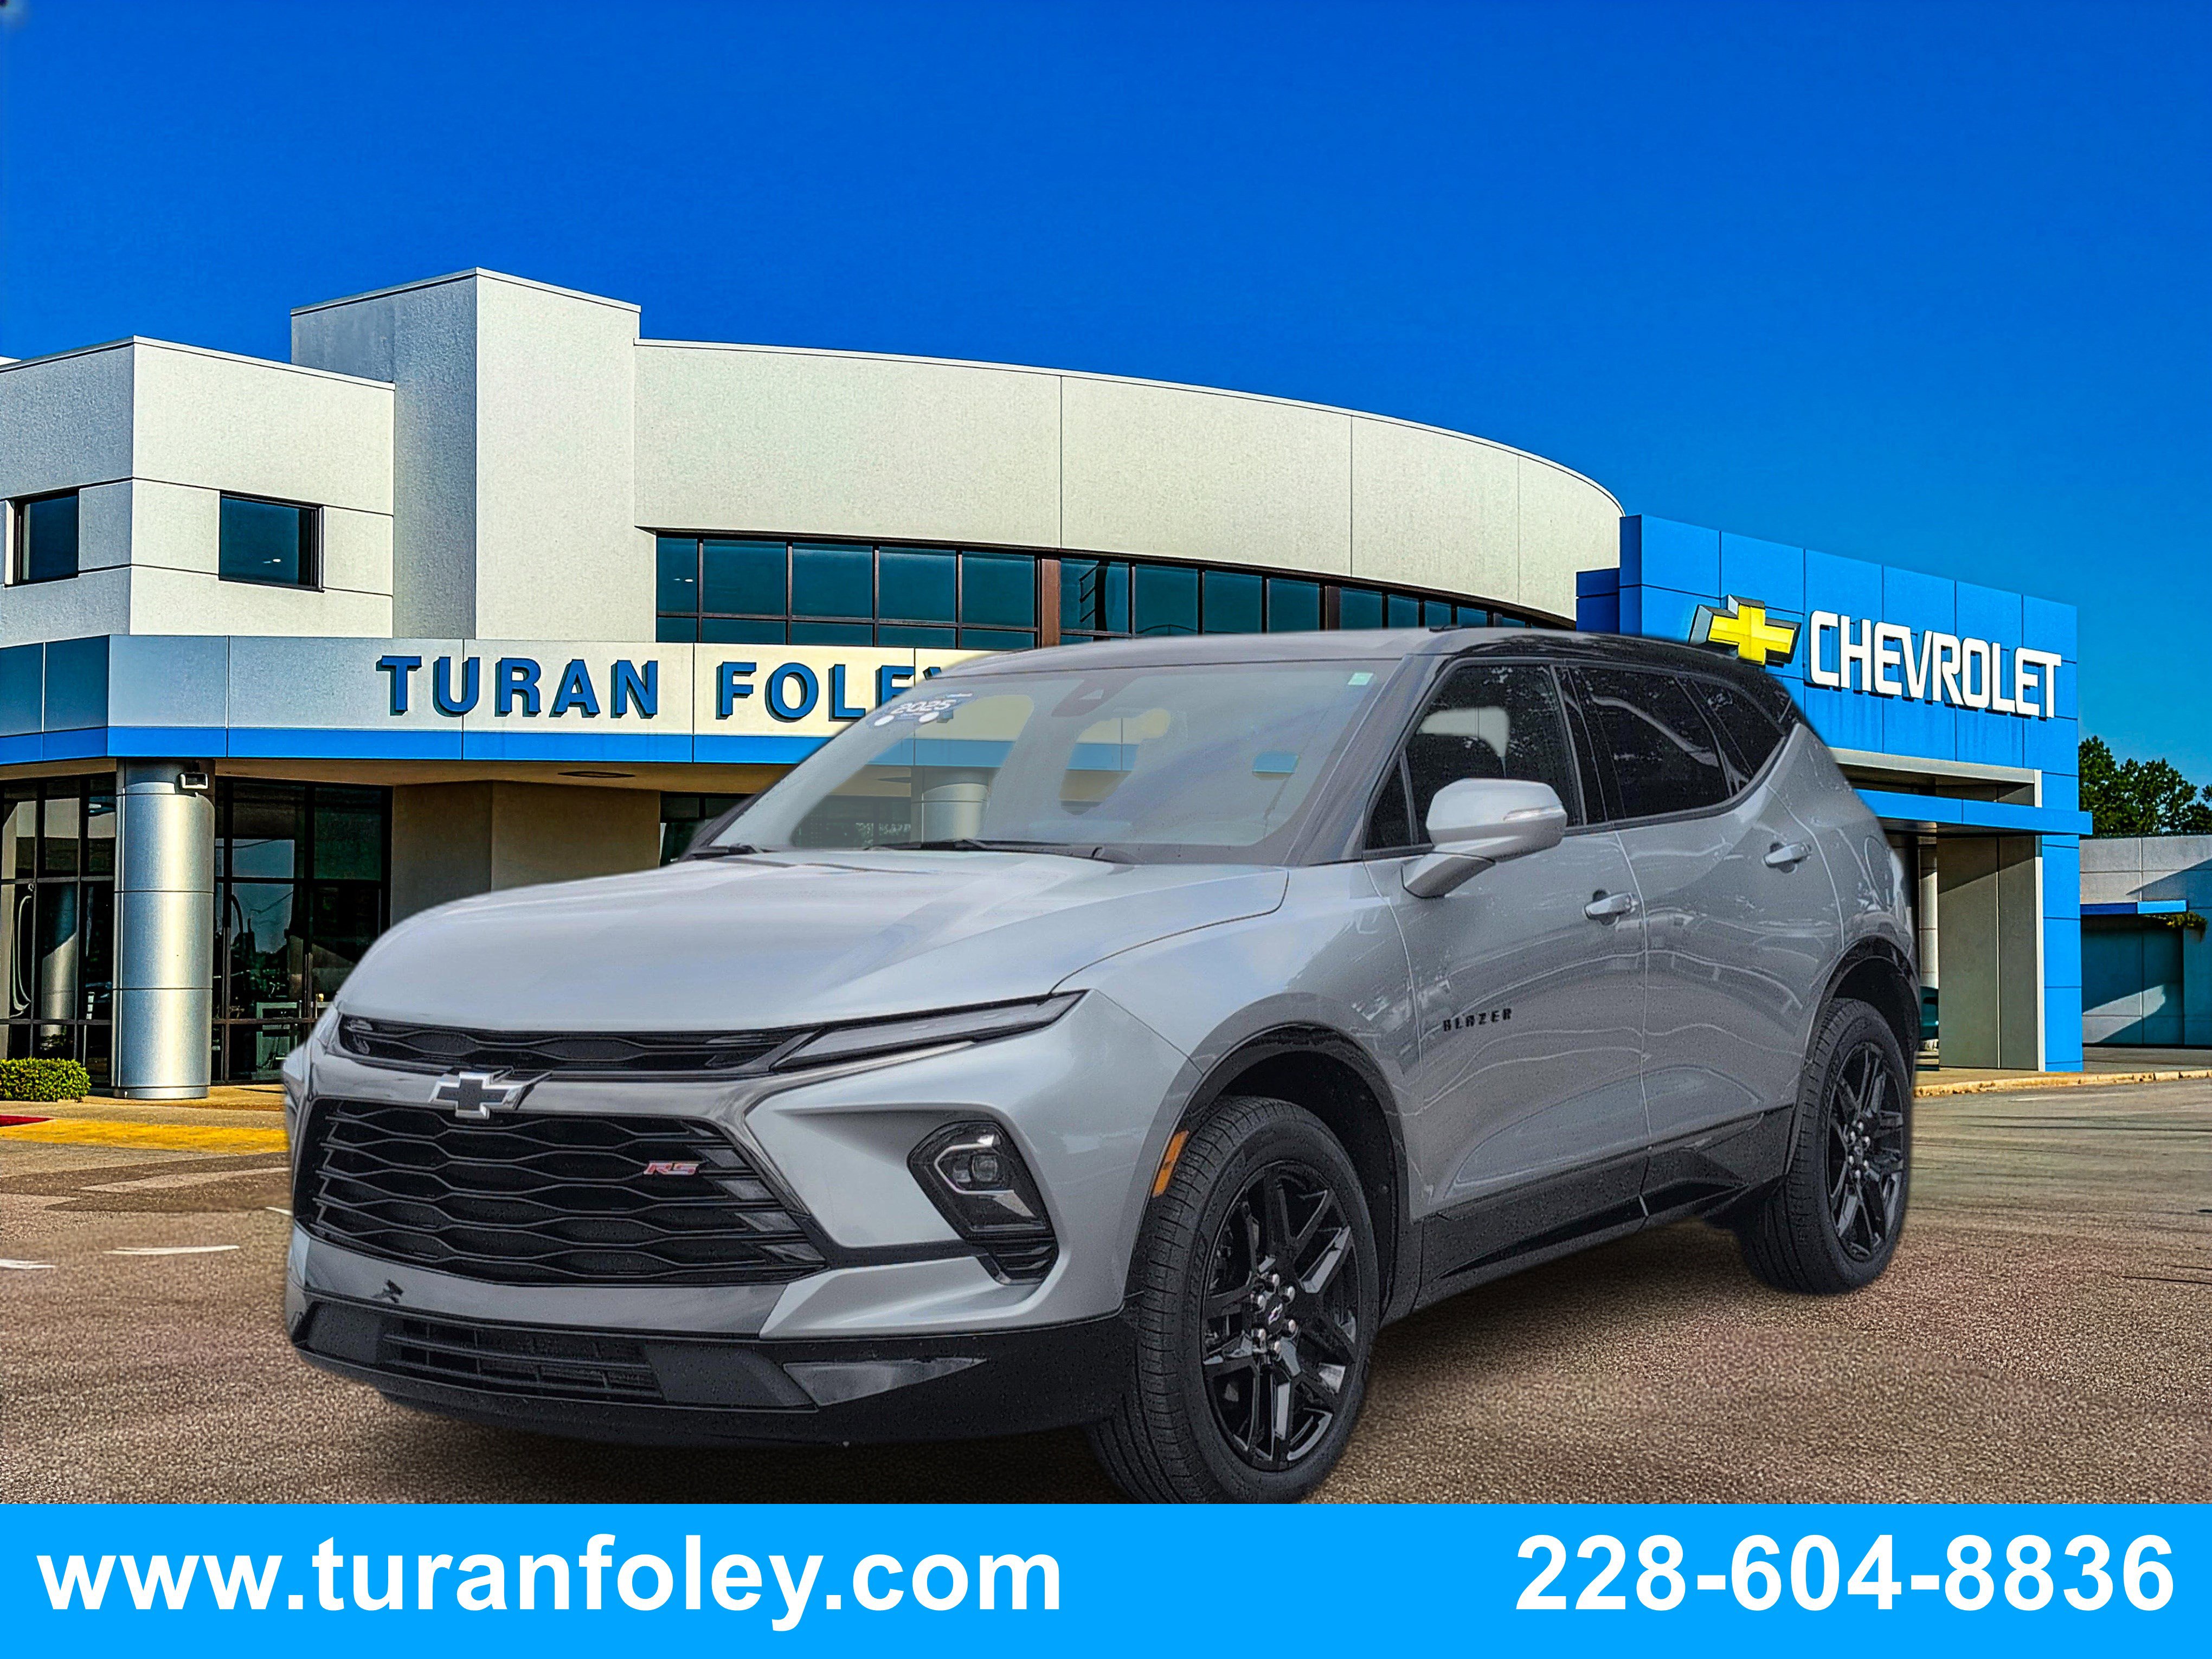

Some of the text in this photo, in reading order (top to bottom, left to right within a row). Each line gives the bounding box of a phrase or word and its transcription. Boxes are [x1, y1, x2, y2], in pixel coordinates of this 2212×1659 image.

[1809, 609, 2062, 719] CHEVROLET
[376, 654, 943, 723] TURAN FOLE
[890, 699, 957, 715] 2025
[1443, 1007, 1512, 1032] BLAZER
[643, 1161, 699, 1175] RS
